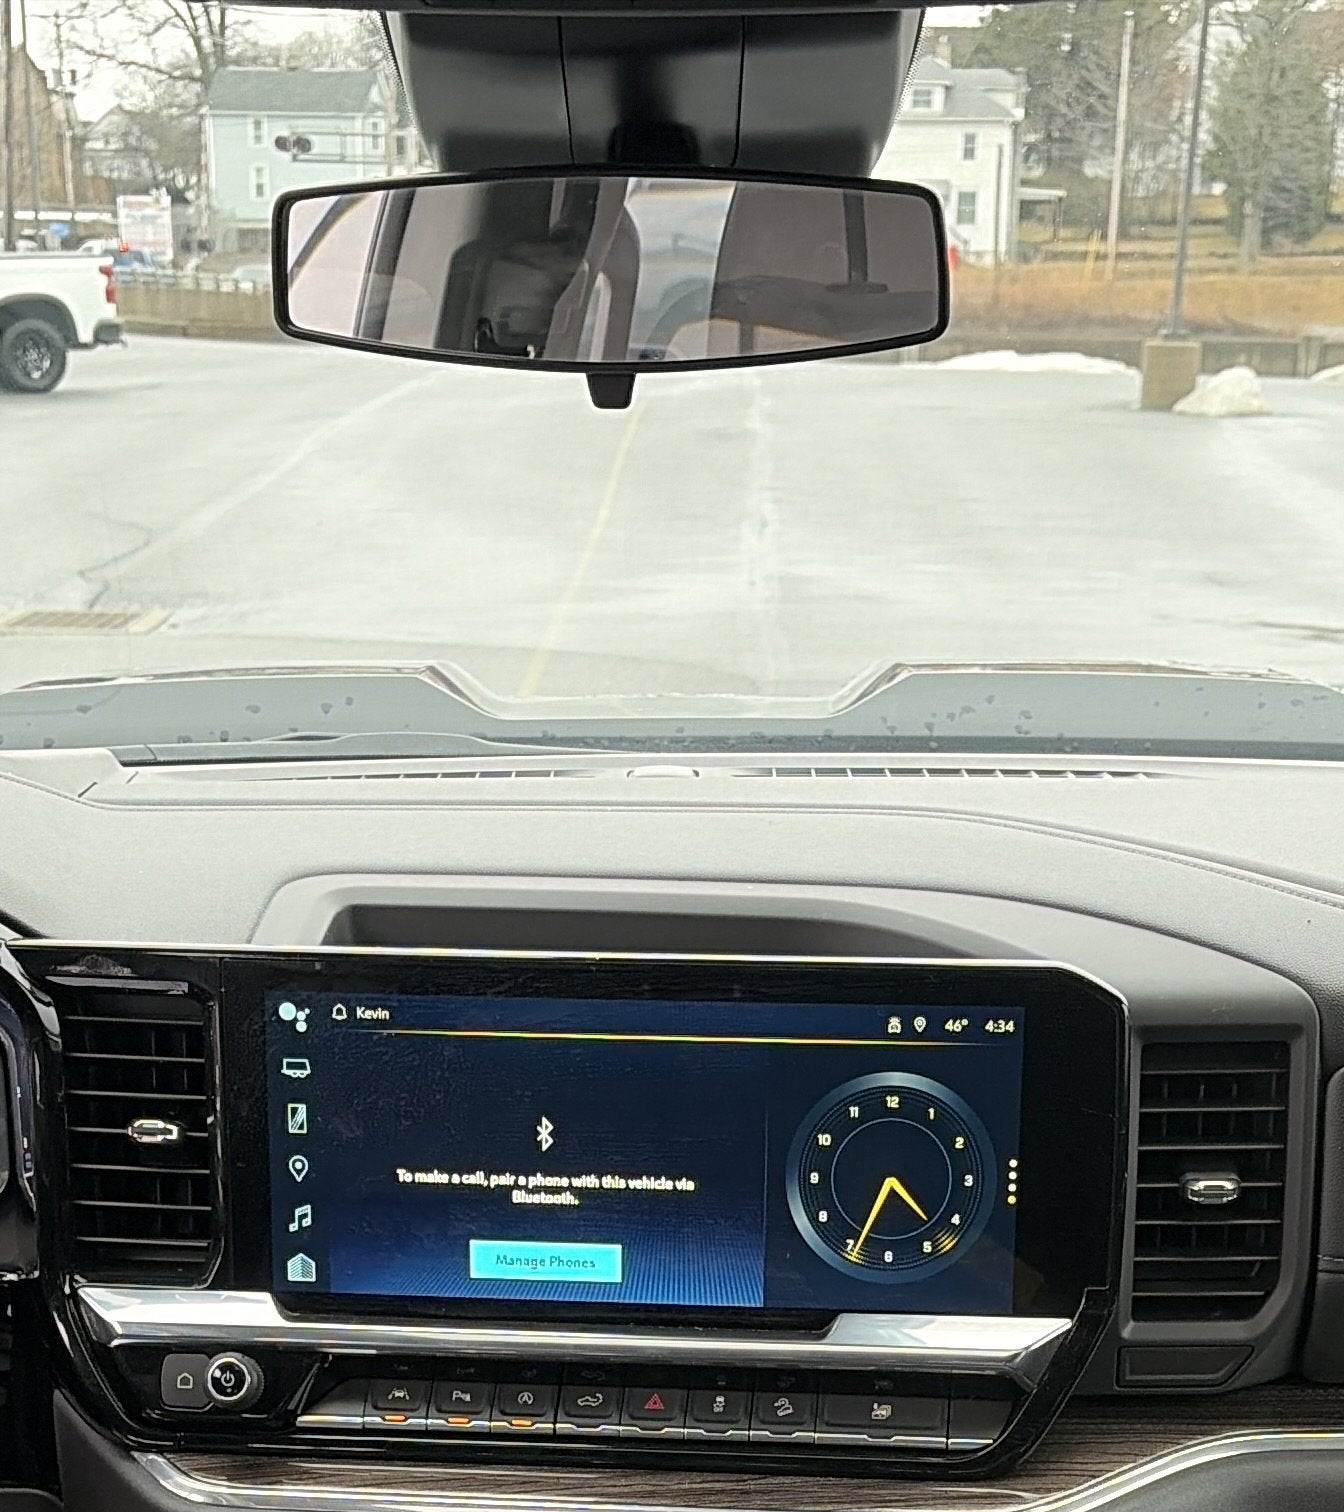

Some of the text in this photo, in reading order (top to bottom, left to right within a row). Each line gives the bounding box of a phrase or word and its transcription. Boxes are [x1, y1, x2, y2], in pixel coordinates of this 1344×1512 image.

[356, 1006, 390, 1020] Kevin
[984, 1020, 1015, 1033] 4:34
[886, 1095, 899, 1108] 12
[849, 1106, 859, 1118] 11
[928, 1108, 935, 1120] 1
[817, 1133, 831, 1145] 10
[955, 1137, 965, 1149] 2
[397, 1168, 695, 1190] To make a call, pair a phone with this vehicle via
[810, 1172, 819, 1184] 9
[964, 1174, 973, 1187] 3
[512, 1190, 580, 1205] Bluetooth.
[818, 1211, 828, 1222] 8
[951, 1214, 960, 1225] 4
[923, 1241, 932, 1252] 5
[495, 1254, 596, 1270] Manage Phones
[884, 1251, 893, 1262] 6
